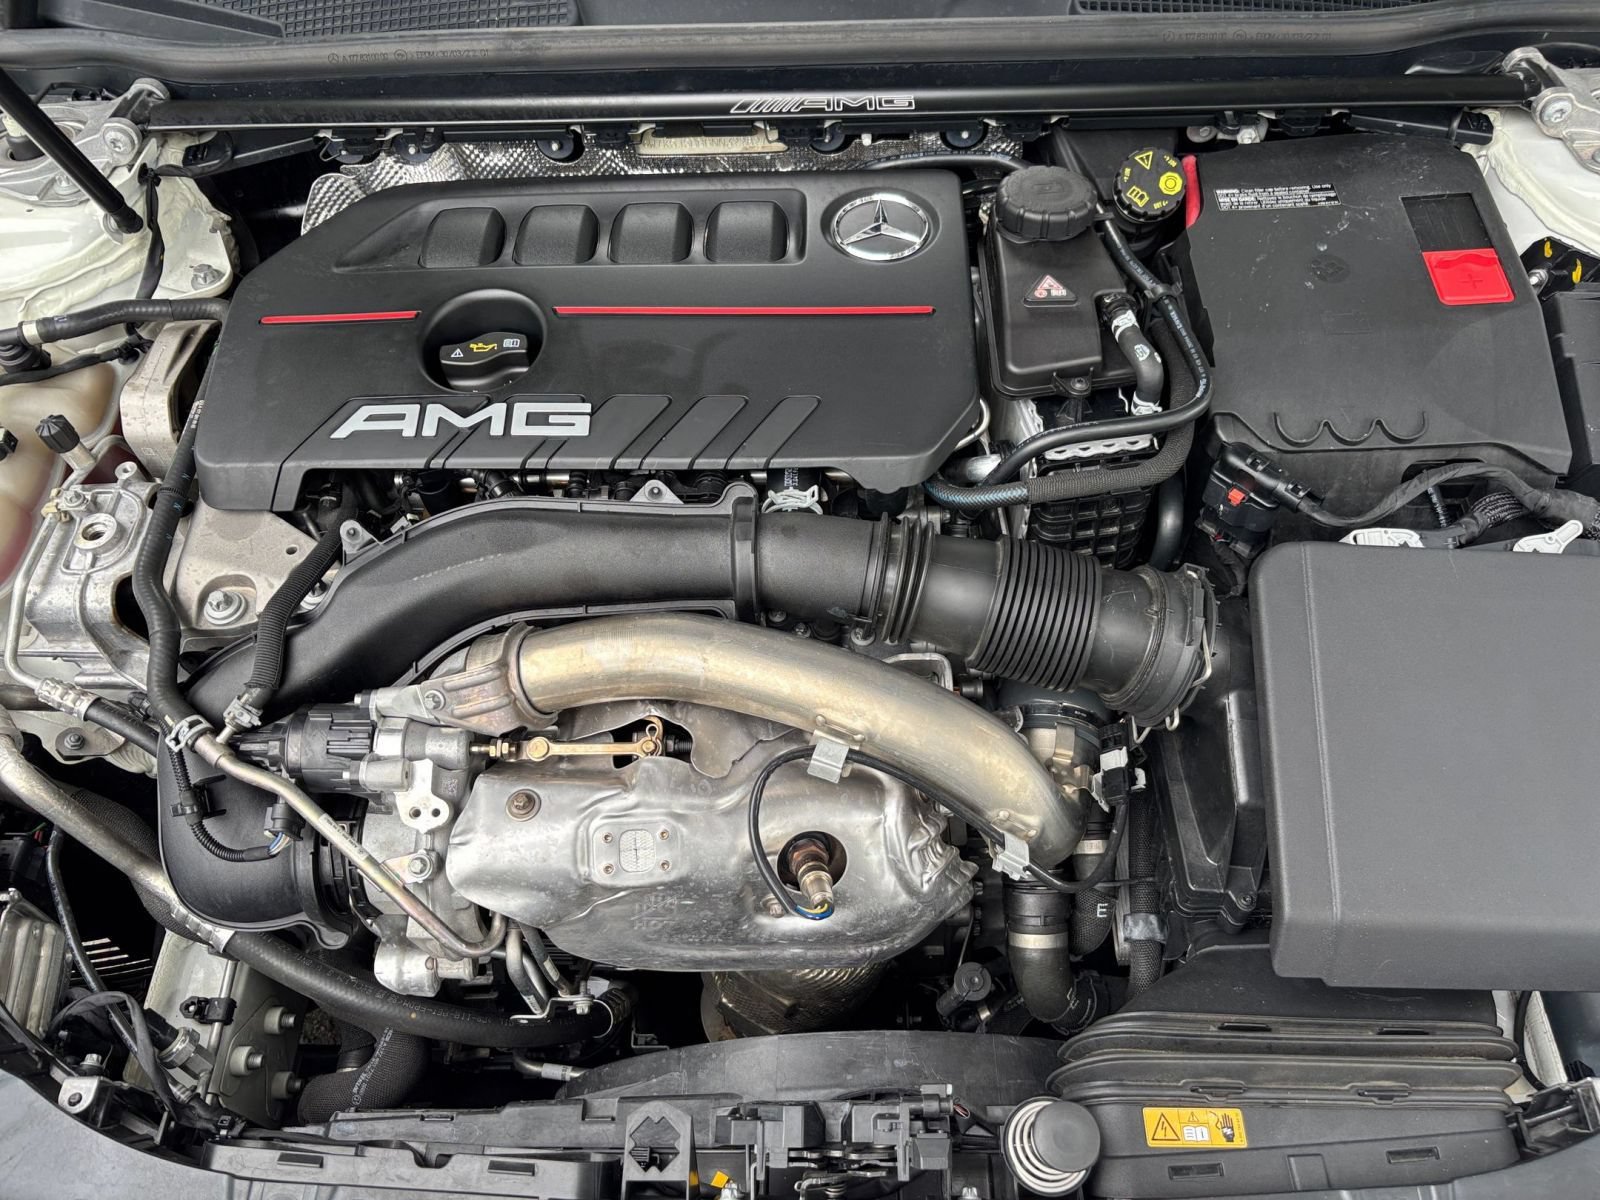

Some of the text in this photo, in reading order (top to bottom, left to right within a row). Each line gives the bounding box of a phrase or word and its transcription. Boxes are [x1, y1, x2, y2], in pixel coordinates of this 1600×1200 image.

[790, 94, 916, 112] AMG
[329, 402, 593, 440] AMG
[1096, 903, 1109, 918] E
